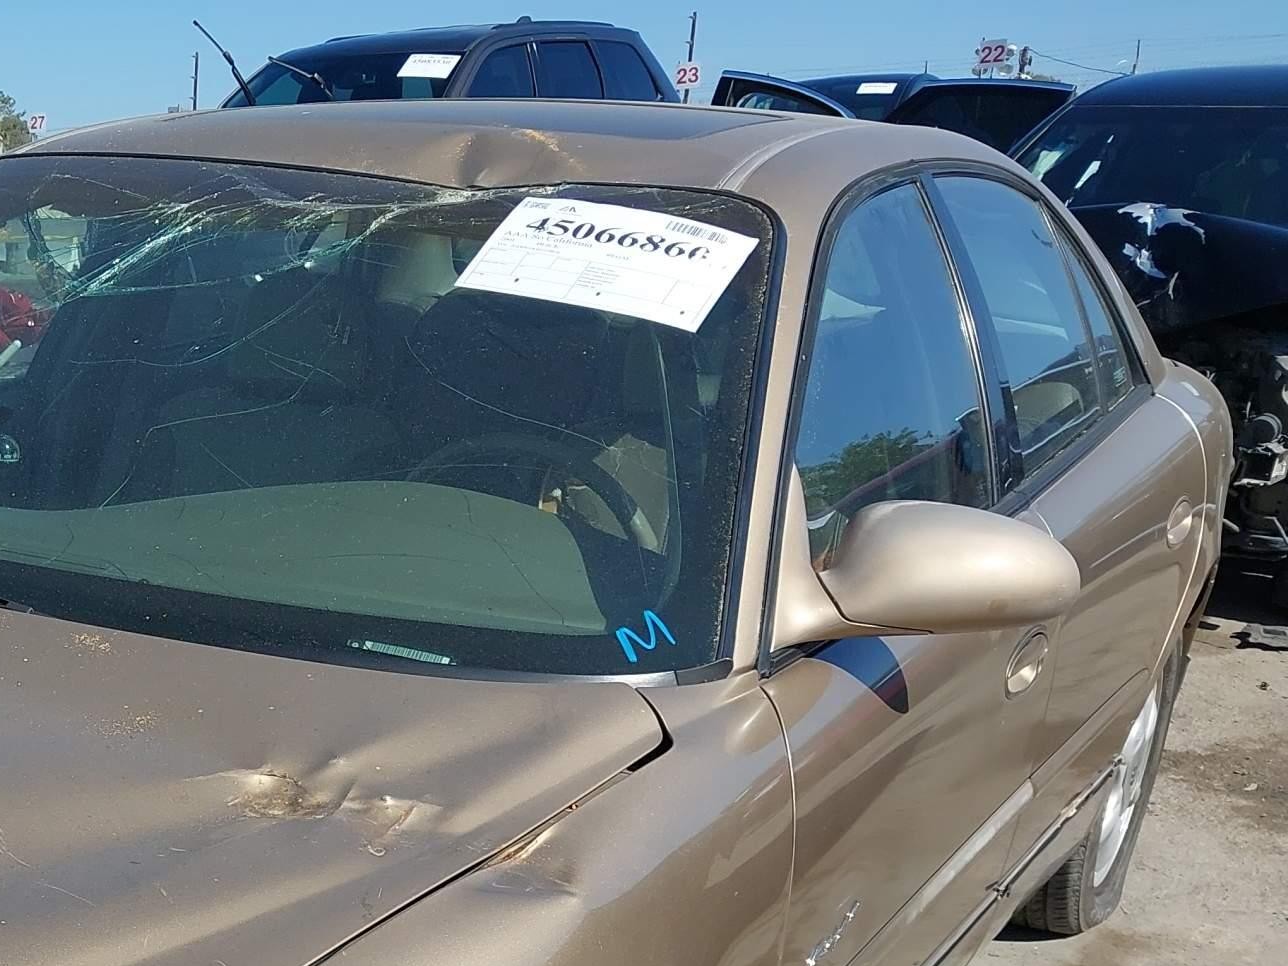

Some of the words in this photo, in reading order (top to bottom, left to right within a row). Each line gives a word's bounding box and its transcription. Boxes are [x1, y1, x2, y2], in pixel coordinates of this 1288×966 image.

[980, 45, 1005, 64] 22
[677, 67, 699, 84] 23
[31, 116, 45, 129] 27
[615, 609, 676, 663] M
